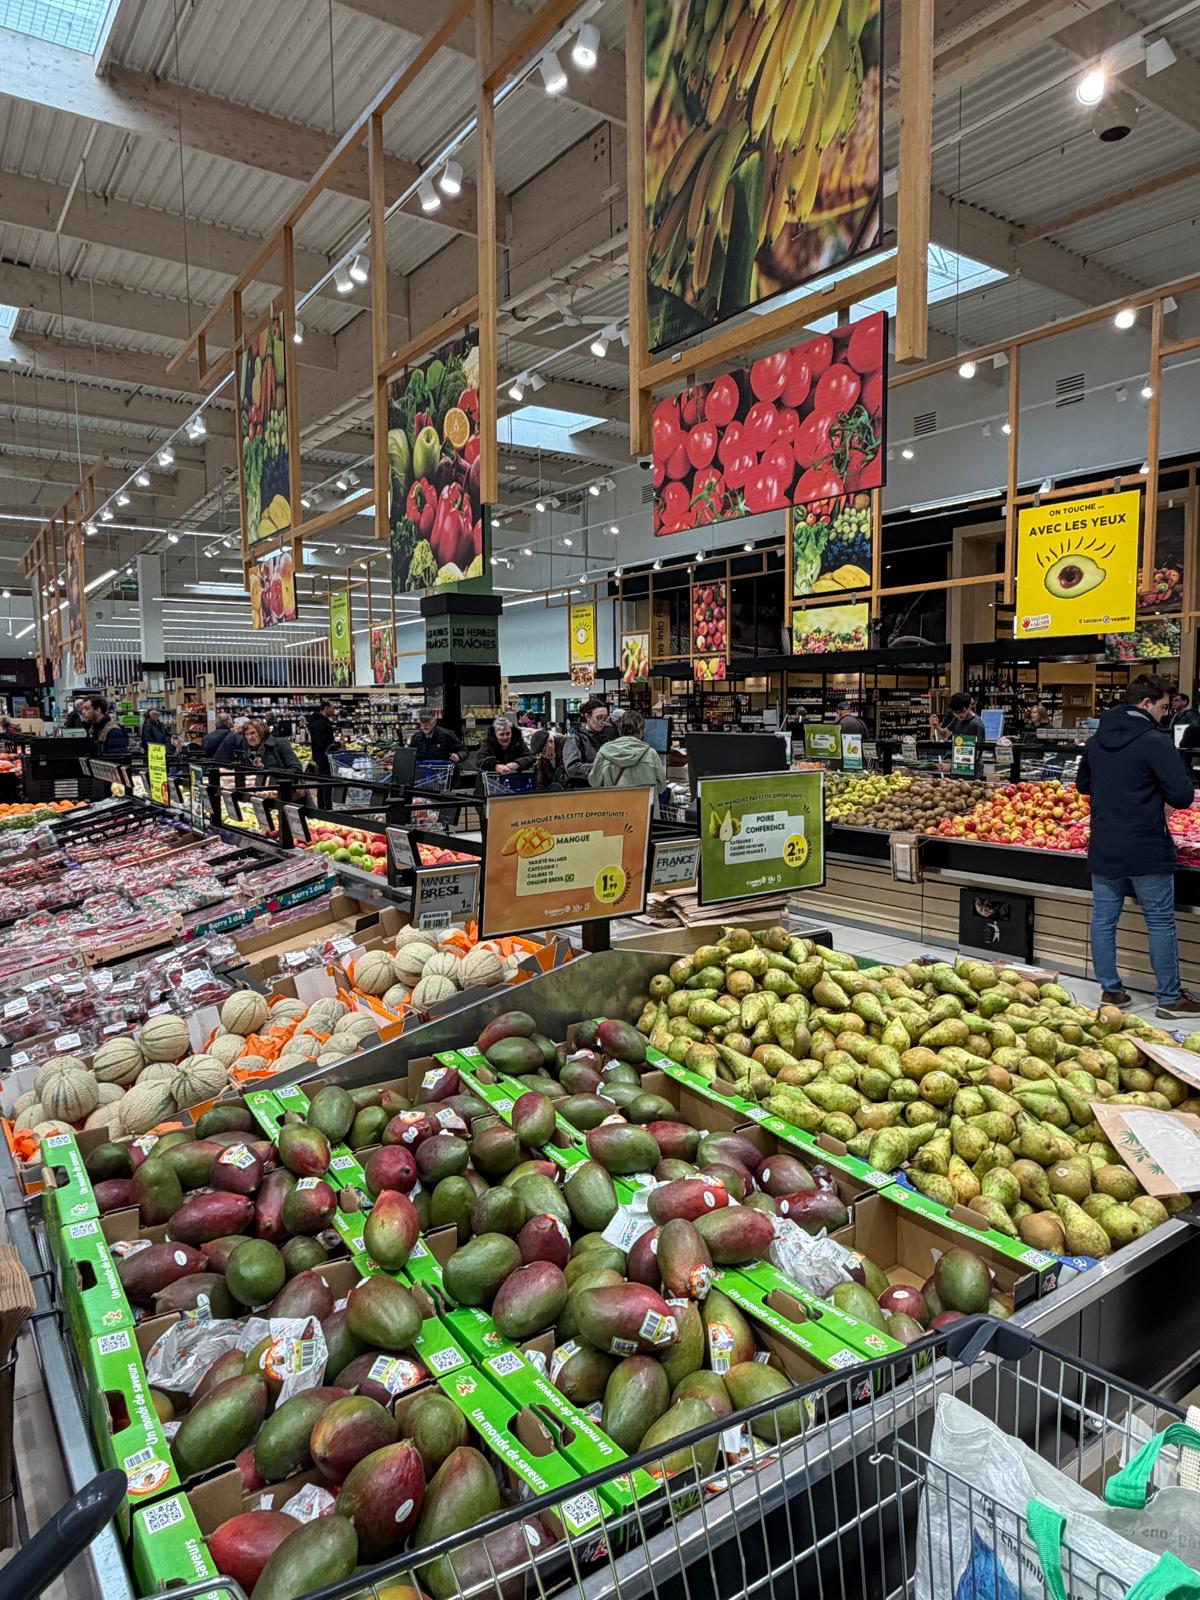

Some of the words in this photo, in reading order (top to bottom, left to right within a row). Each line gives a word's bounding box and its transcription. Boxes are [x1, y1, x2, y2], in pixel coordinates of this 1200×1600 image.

[1049, 508, 1061, 517] ON
[1063, 503, 1096, 514] TOUCHE
[1029, 523, 1062, 537] AVEC
[1065, 518, 1088, 531] LES
[1091, 513, 1127, 528] YEUX
[466, 628, 496, 638] HERBES
[520, 816, 552, 825] MANQUEZ
[756, 814, 775, 823] POIRE
[556, 835, 590, 845] MANGUE
[656, 854, 695, 868] FRANCE
[291, 888, 309, 900] Berry
[421, 885, 462, 899] BRESIL
[208, 920, 228, 930] Berry
[811, 1298, 845, 1321] monde
[728, 1288, 741, 1301] Un
[738, 1296, 770, 1319] monde
[767, 1314, 781, 1327] de
[778, 1321, 813, 1349] saveurs
[844, 1315, 858, 1327] Un
[128, 1362, 143, 1393] saveurs
[132, 1392, 146, 1405] de
[533, 1379, 564, 1408] saveurs
[136, 1405, 155, 1429] monde
[559, 1405, 573, 1418] de
[571, 1410, 602, 1443] monde
[145, 1428, 158, 1447] Un
[471, 1408, 484, 1423] Un
[481, 1416, 511, 1451] monde
[506, 1444, 521, 1461] de
[515, 1456, 549, 1491] saveurs
[599, 1440, 613, 1456] Un
[185, 1538, 209, 1578] saveurs
